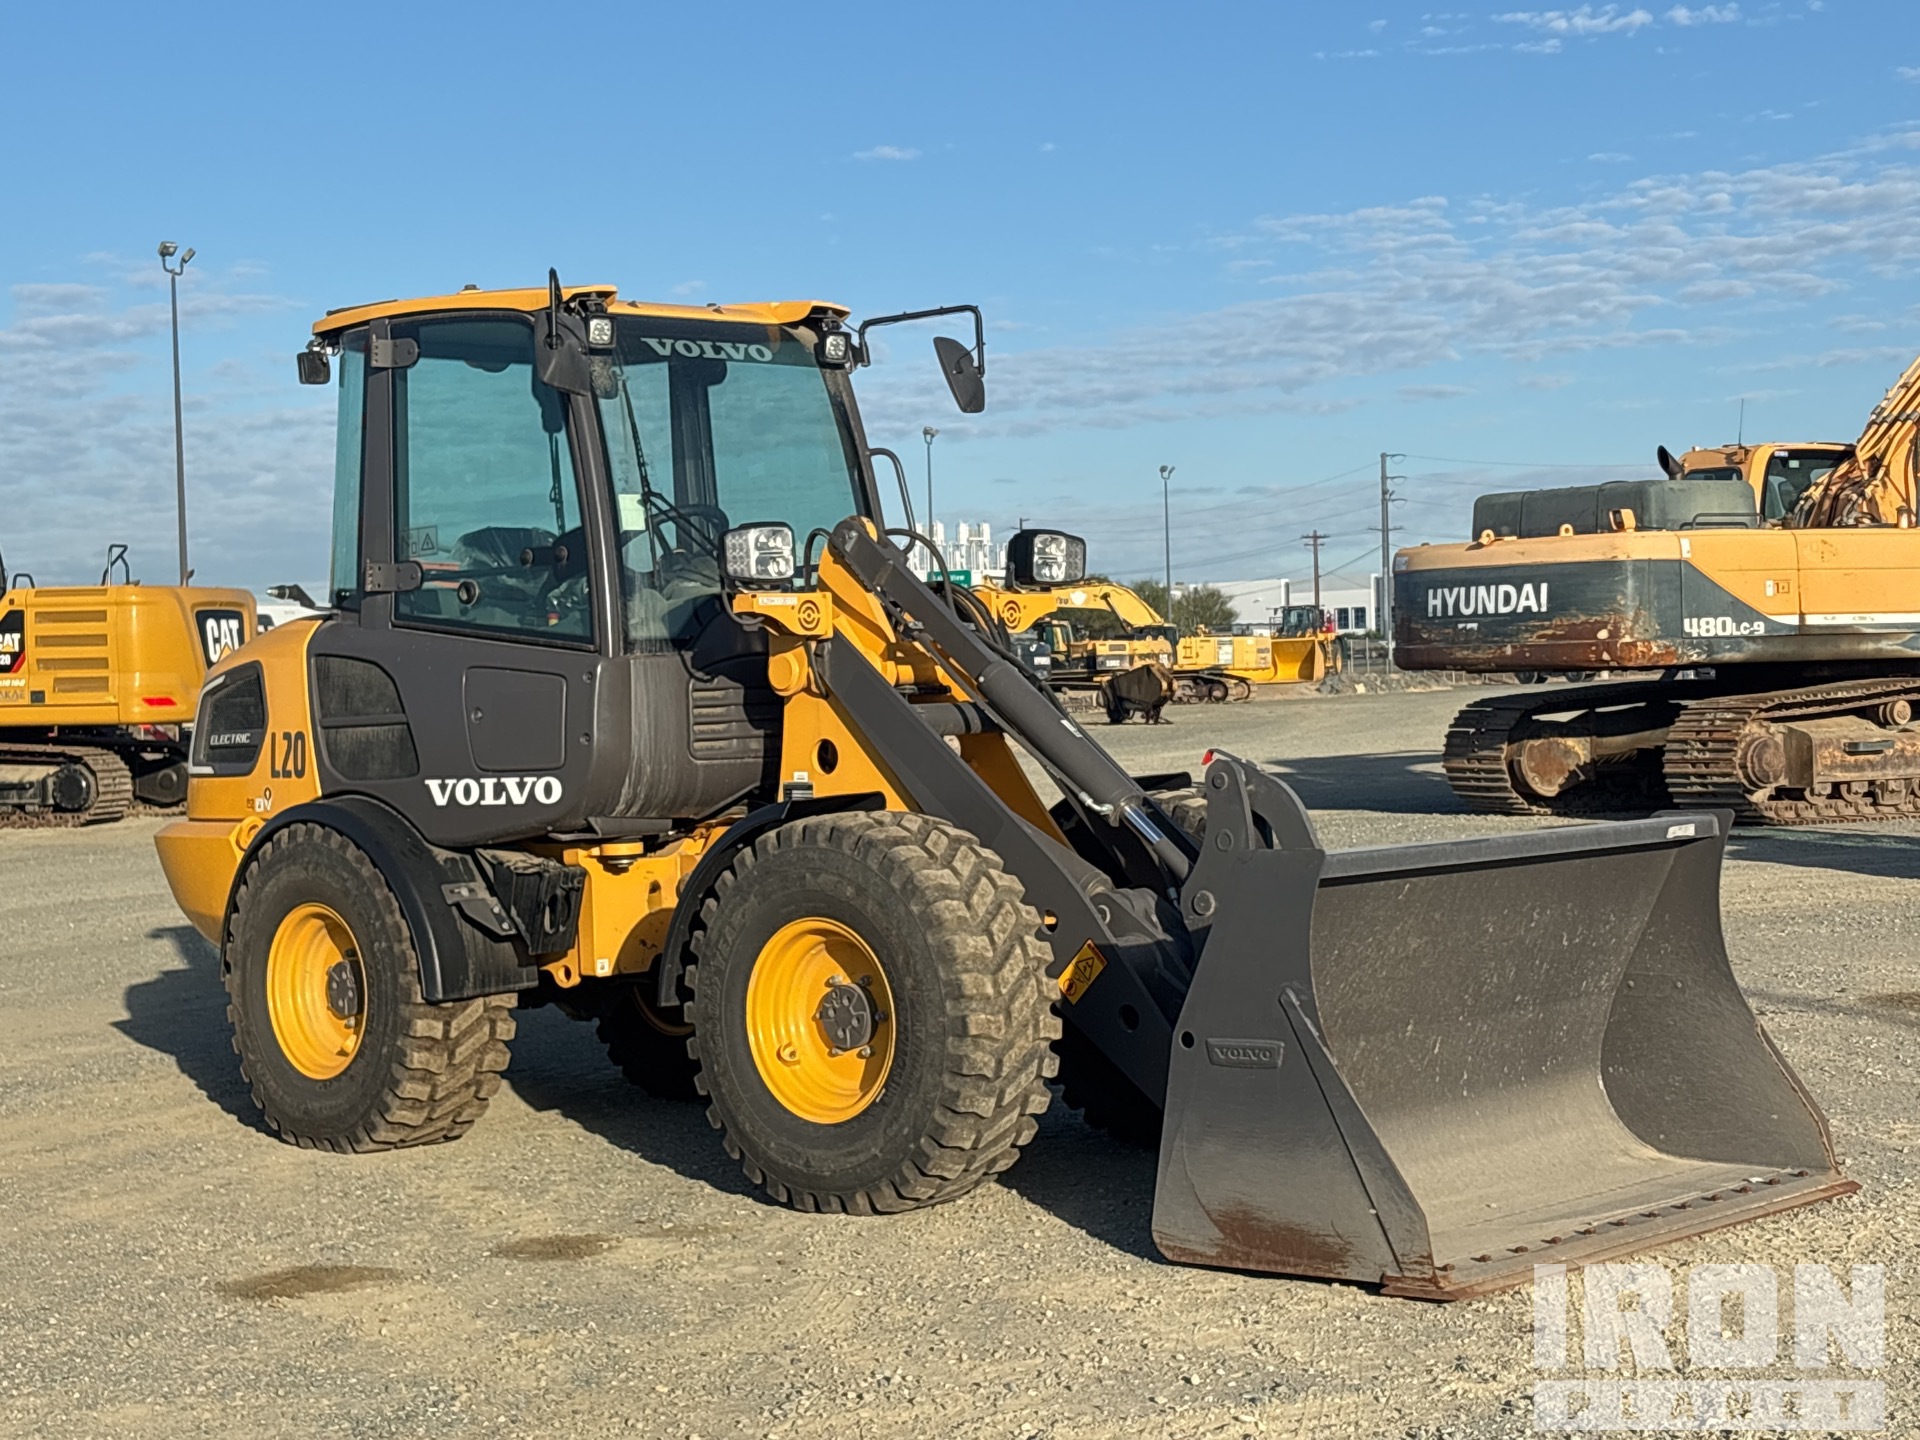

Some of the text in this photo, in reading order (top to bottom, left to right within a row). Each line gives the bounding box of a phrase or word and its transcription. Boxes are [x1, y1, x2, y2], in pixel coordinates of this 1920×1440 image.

[641, 337, 773, 363] VOLVO
[1427, 582, 1548, 618] HYUNDAI
[206, 617, 240, 663] CAT
[0, 654, 11, 665] 20
[210, 732, 251, 745] ELECTRIC
[270, 731, 306, 779] L20
[425, 775, 562, 807] VOLVO
[1215, 1046, 1273, 1061] VOLVO
